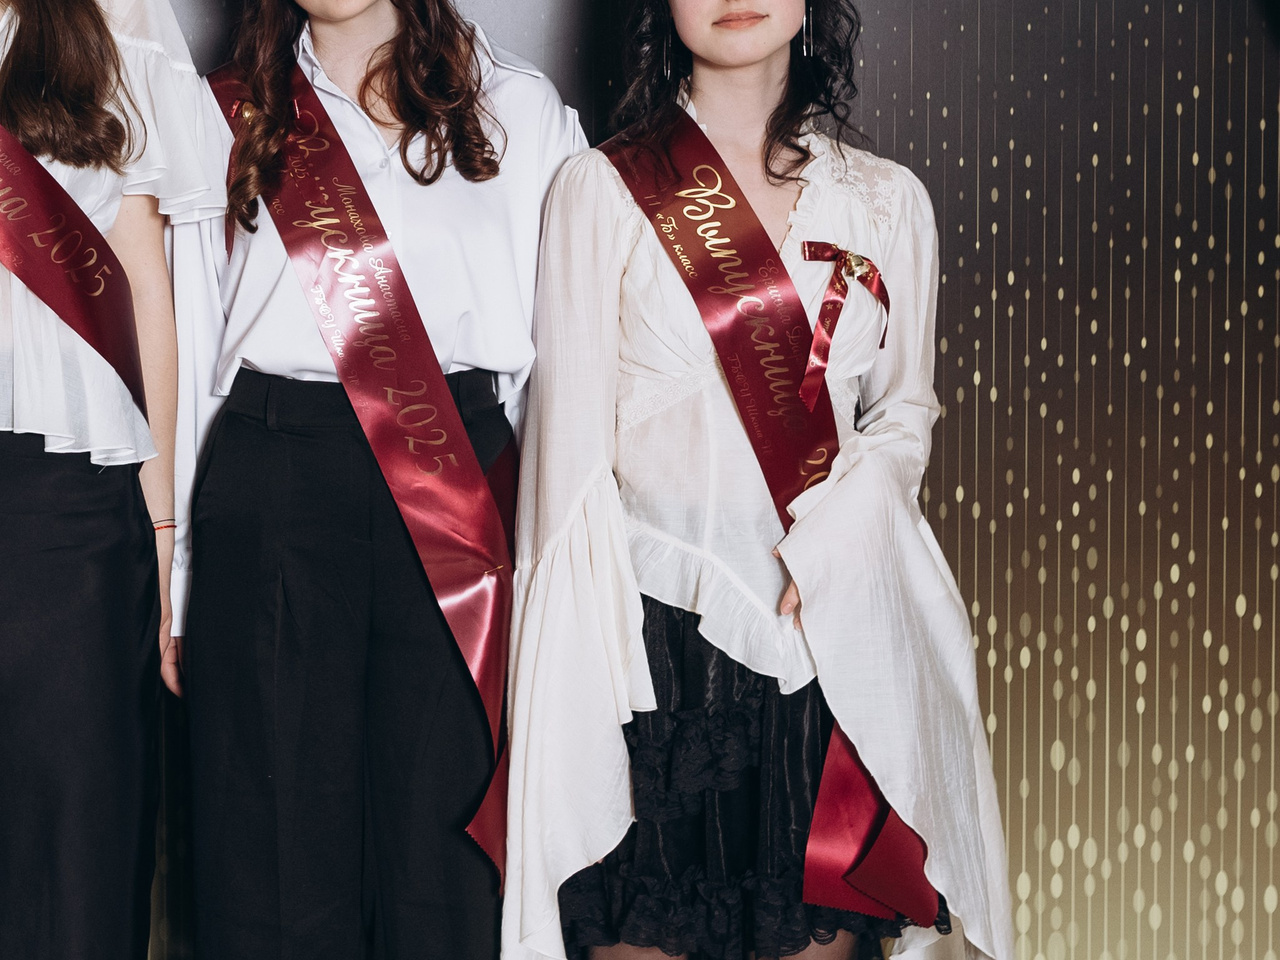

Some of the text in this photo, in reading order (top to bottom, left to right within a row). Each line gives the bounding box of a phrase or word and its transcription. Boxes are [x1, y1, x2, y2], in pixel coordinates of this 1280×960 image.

[288, 155, 310, 180] 2025
[27, 213, 112, 298] 2025
[292, 108, 397, 371] Вускница
[332, 176, 412, 342] Монахова Анастасия
[645, 193, 662, 207] 11
[672, 240, 699, 281] класс
[310, 284, 337, 329] ГБОУ
[673, 163, 807, 428] Выпускница
[726, 352, 752, 399] ГБОУ
[382, 379, 460, 477] 2025
